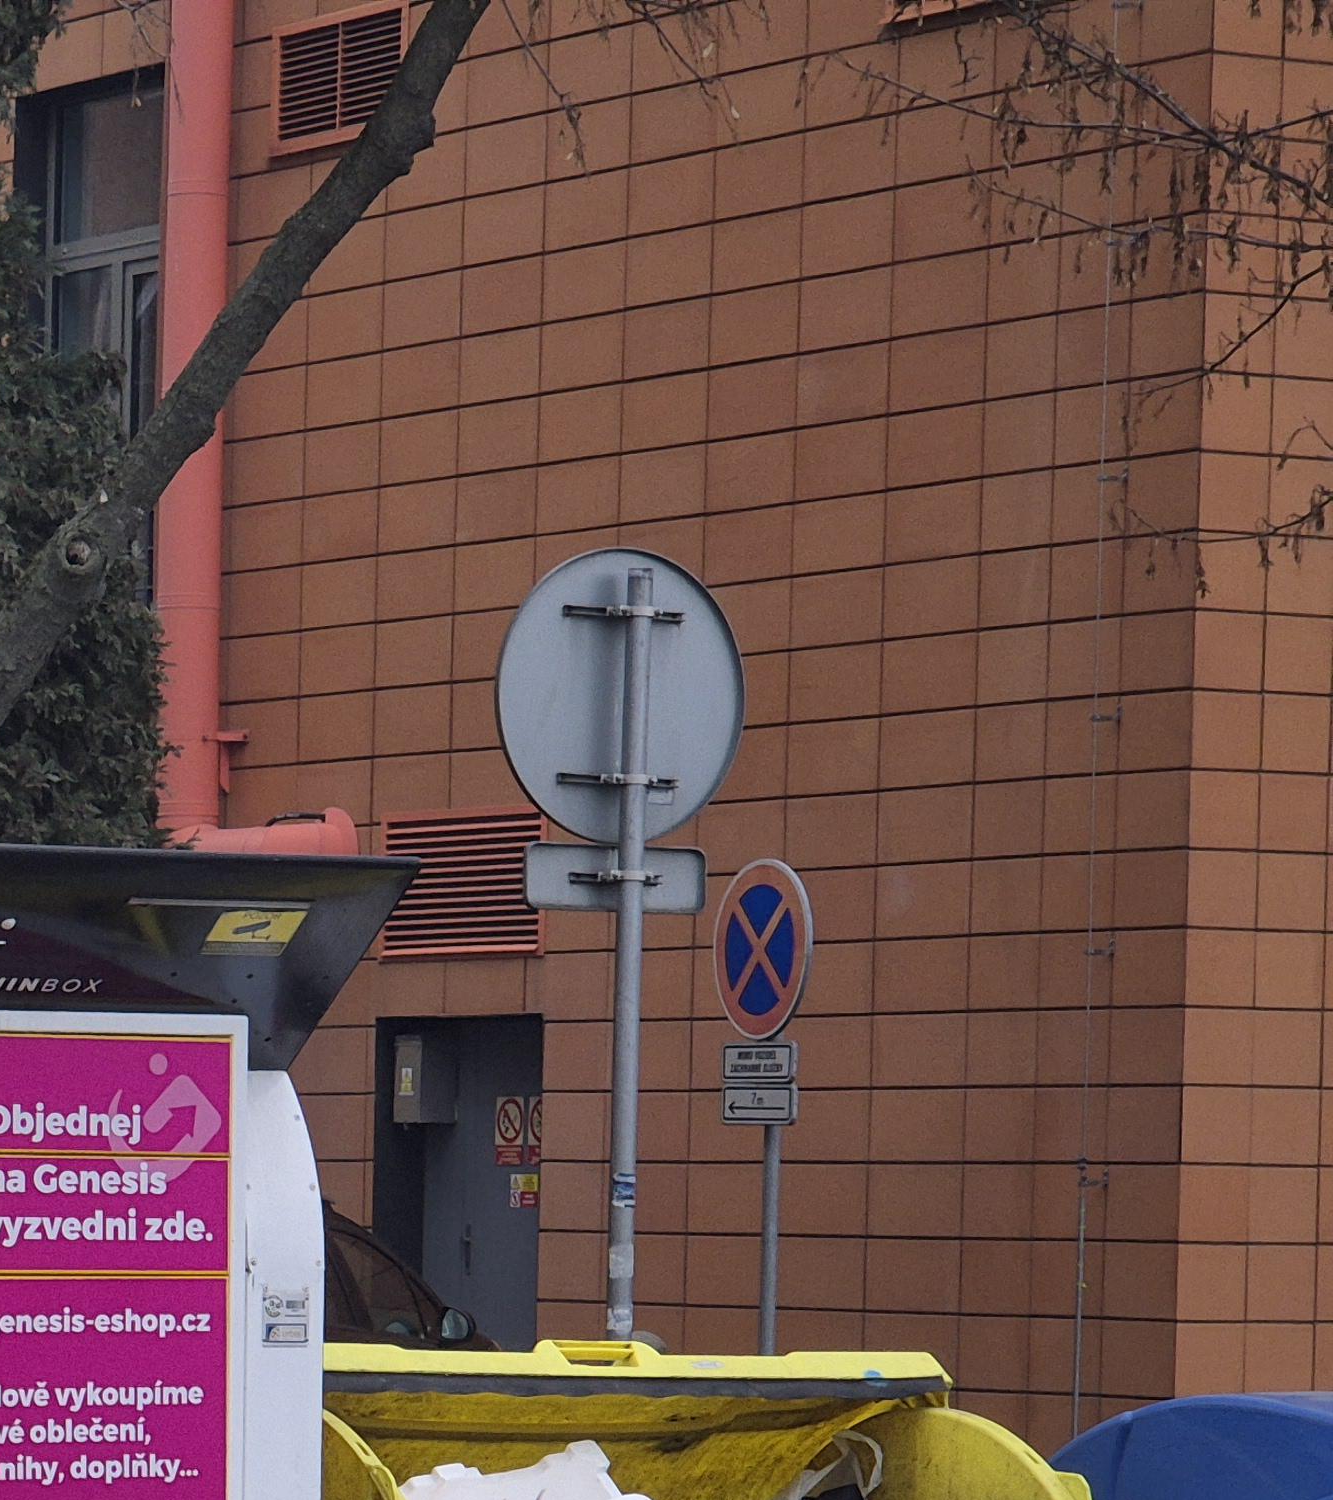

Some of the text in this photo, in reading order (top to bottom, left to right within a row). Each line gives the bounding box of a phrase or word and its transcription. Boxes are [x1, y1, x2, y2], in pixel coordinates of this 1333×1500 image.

[33, 1161, 167, 1195] Genesis
[144, 1210, 214, 1242] zde.
[55, 1381, 205, 1412] vykoupíme
[30, 1417, 151, 1446] oblečení,
[69, 1454, 200, 1485] doplňky...
